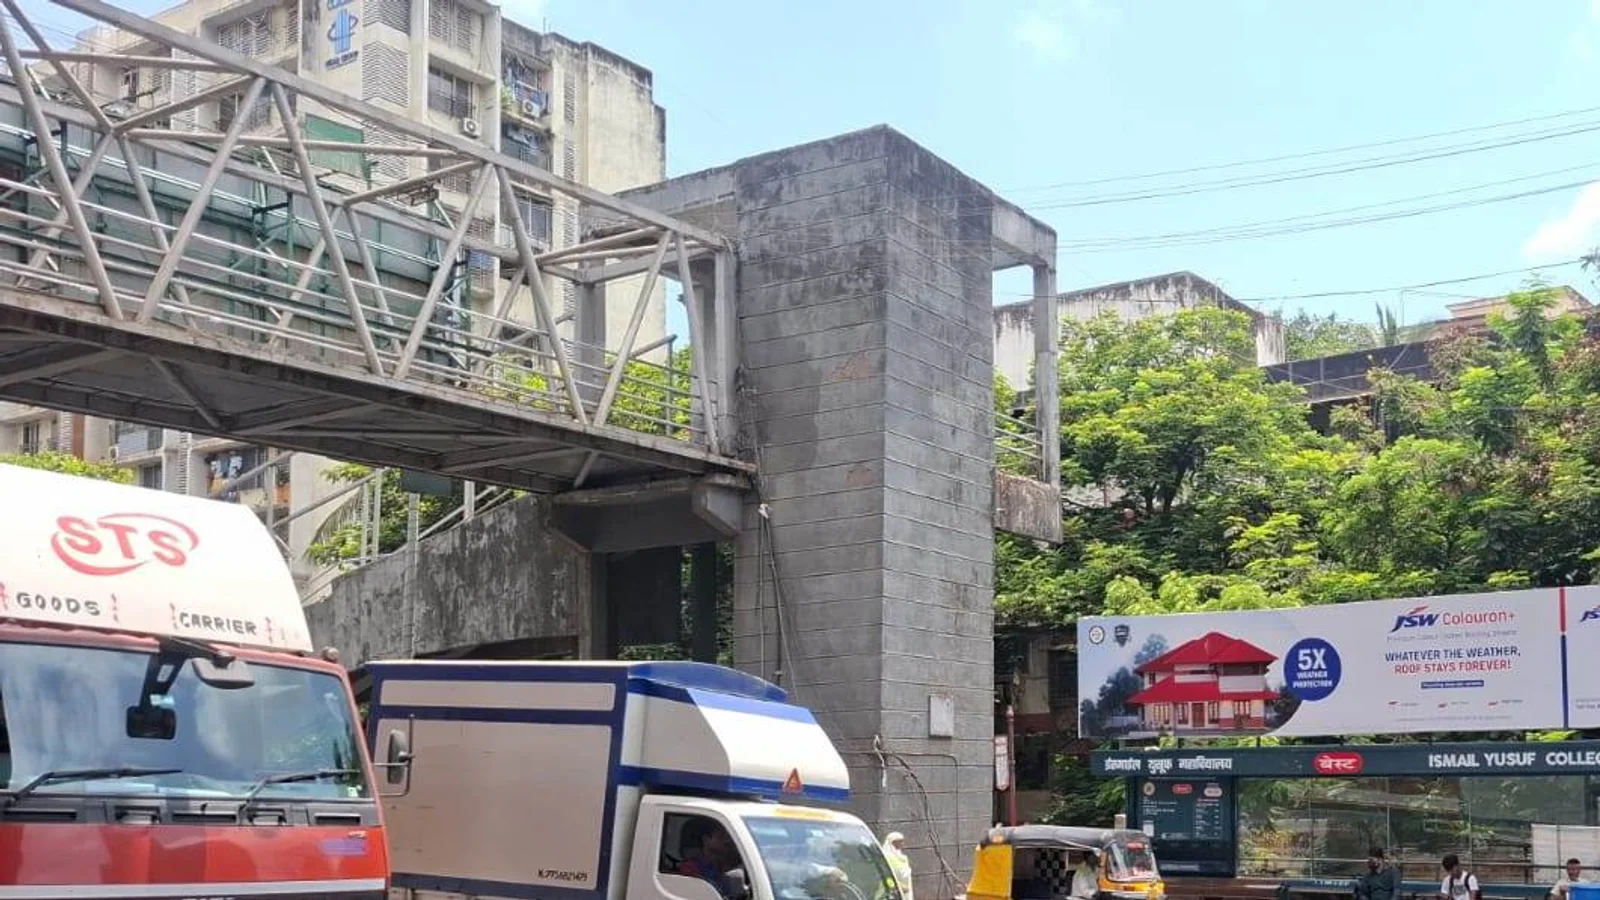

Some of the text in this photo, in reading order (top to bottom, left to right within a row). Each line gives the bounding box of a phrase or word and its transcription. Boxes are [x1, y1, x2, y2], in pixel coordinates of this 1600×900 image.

[56, 515, 187, 567] STS
[16, 591, 257, 636] GOODS CARRIER
[1391, 610, 1516, 633] JSW Colouron+
[1298, 648, 1327, 670] 5X
[1385, 645, 1521, 662] WHATEVER THE WEATHER,
[1395, 658, 1511, 674] ROOF STAYS FOREVER!
[1318, 755, 1358, 770] बेस्ट
[1428, 753, 1480, 768] ISMAIL
[1483, 751, 1536, 767] YUSUF
